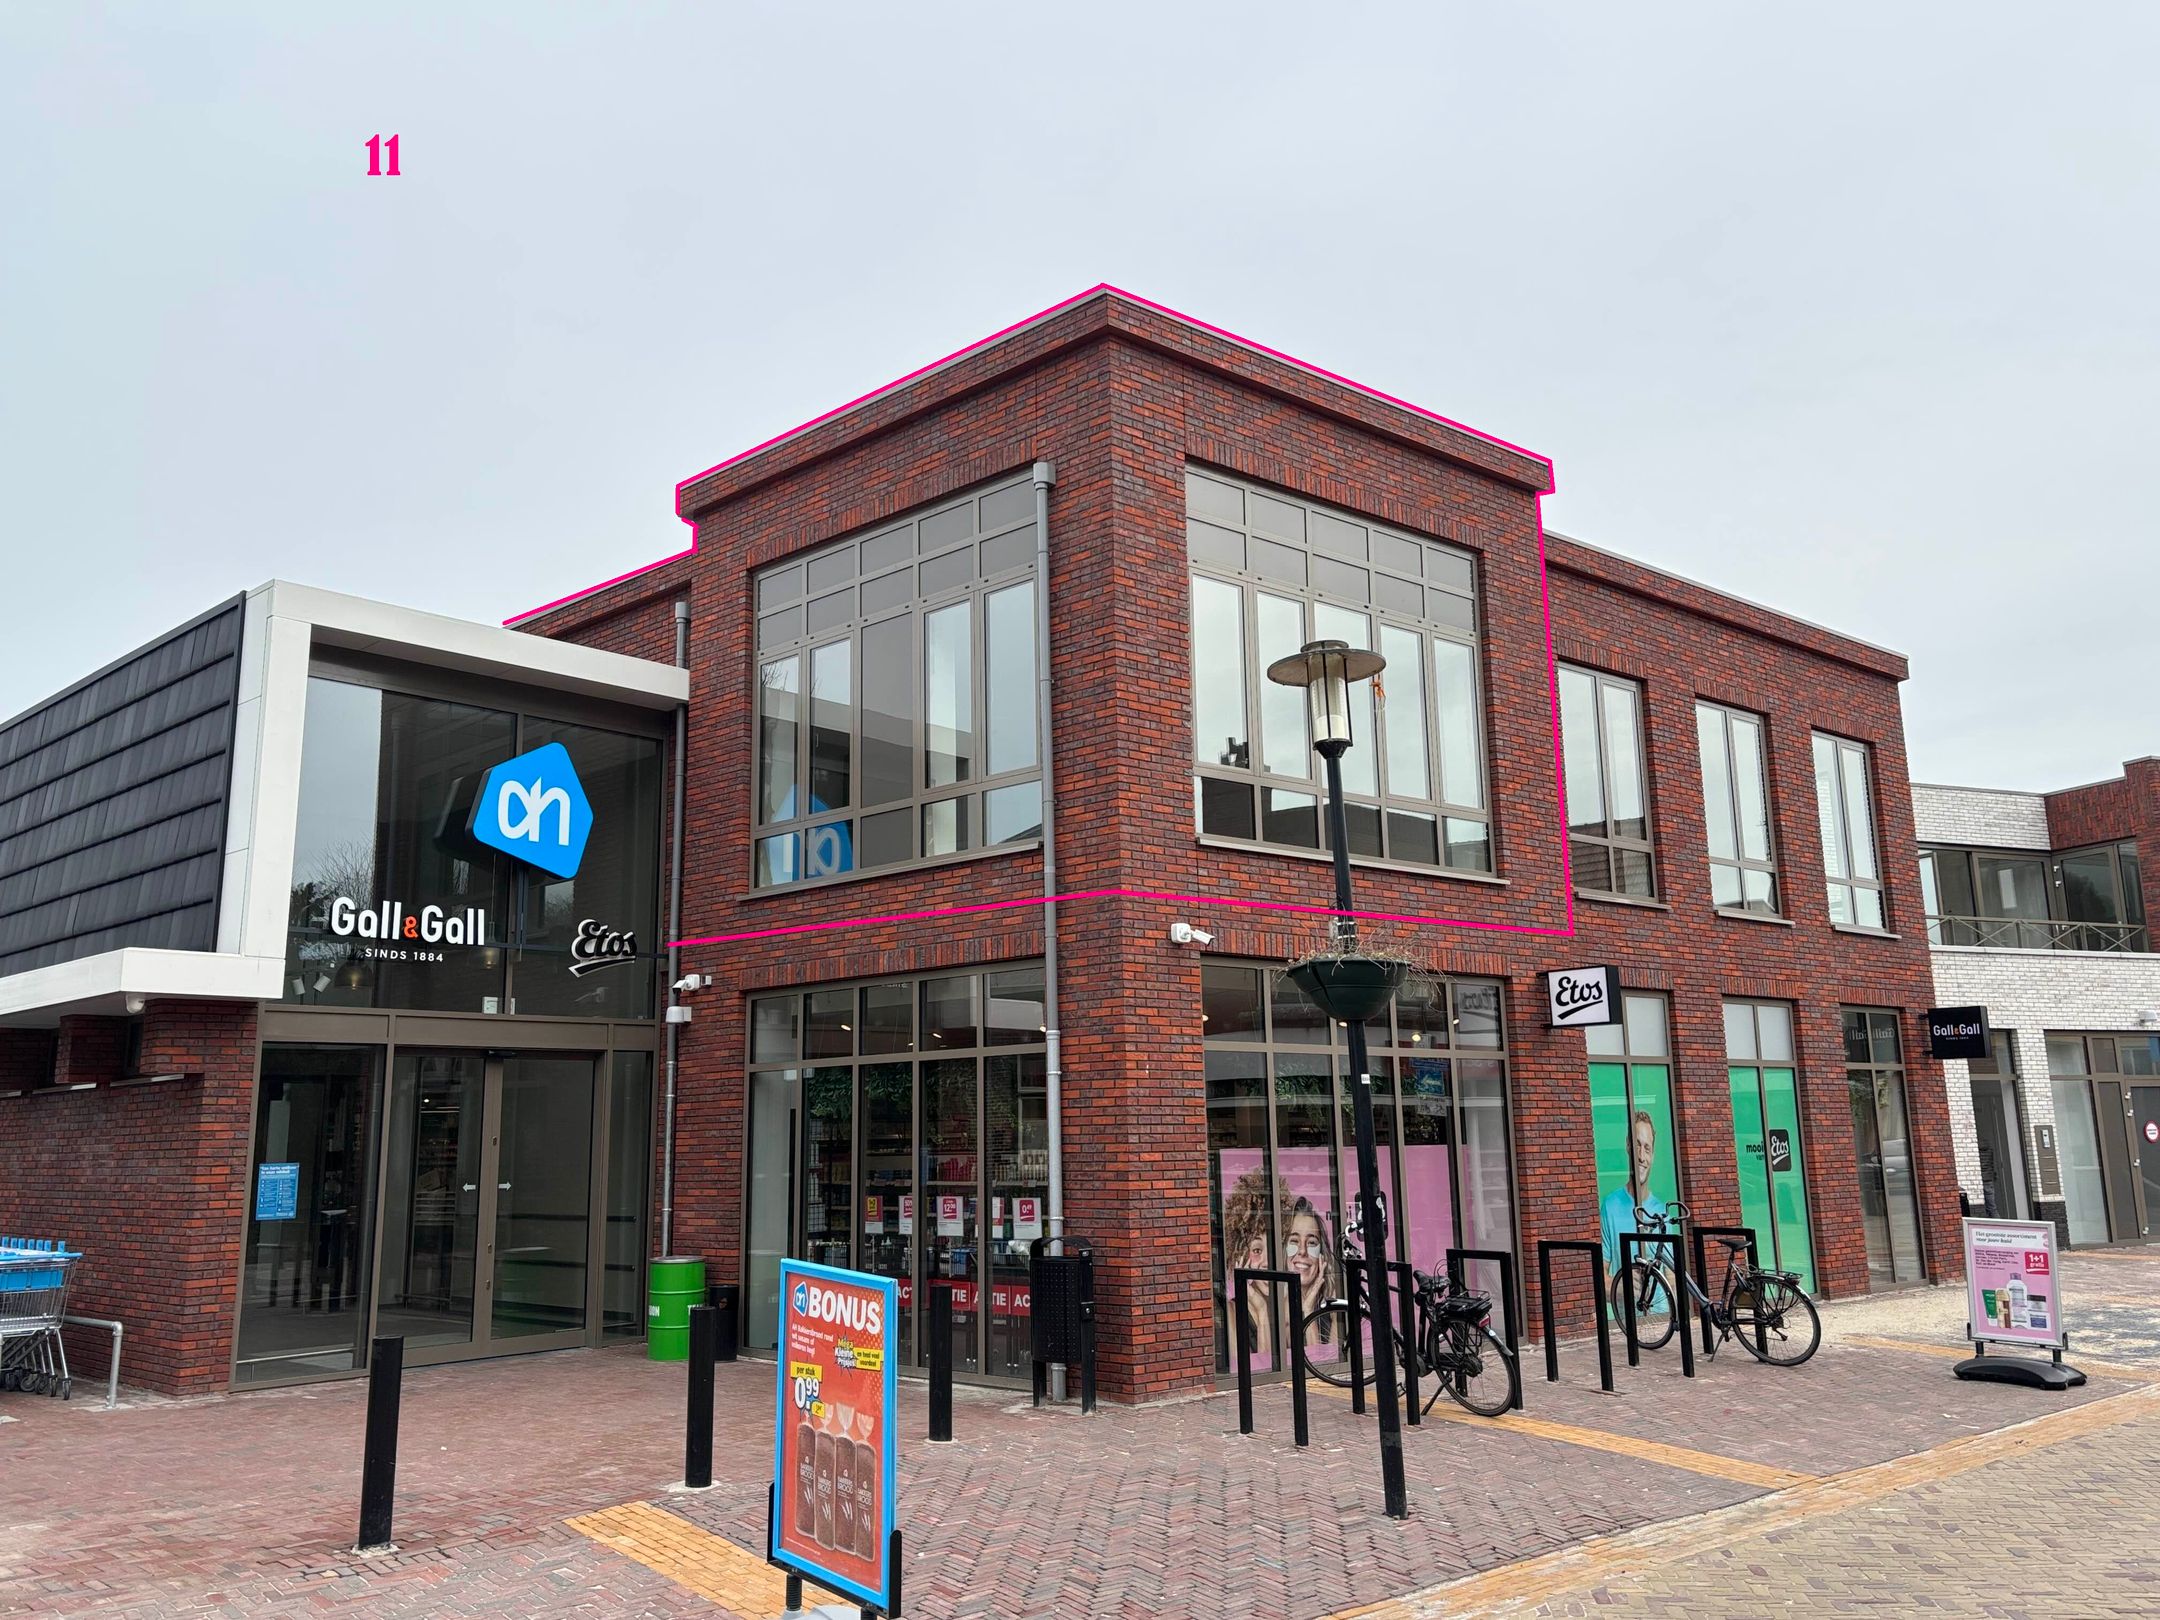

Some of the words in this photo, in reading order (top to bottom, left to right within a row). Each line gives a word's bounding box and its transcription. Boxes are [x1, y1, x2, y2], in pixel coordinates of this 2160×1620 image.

[331, 896, 486, 946] Gall&Gall
[571, 918, 638, 966] Etos
[364, 948, 408, 960] SINDS
[413, 951, 444, 962] 1884
[1555, 976, 1603, 1010] Etos
[1933, 1023, 1981, 1037] Gall&Gall
[1746, 1141, 1764, 1153] mooi
[1771, 1135, 1789, 1157] Etos
[2029, 1254, 2044, 1263] 1+1
[808, 1286, 881, 1335] BONUS
[796, 1365, 804, 1375] per
[805, 1366, 816, 1377] stuk
